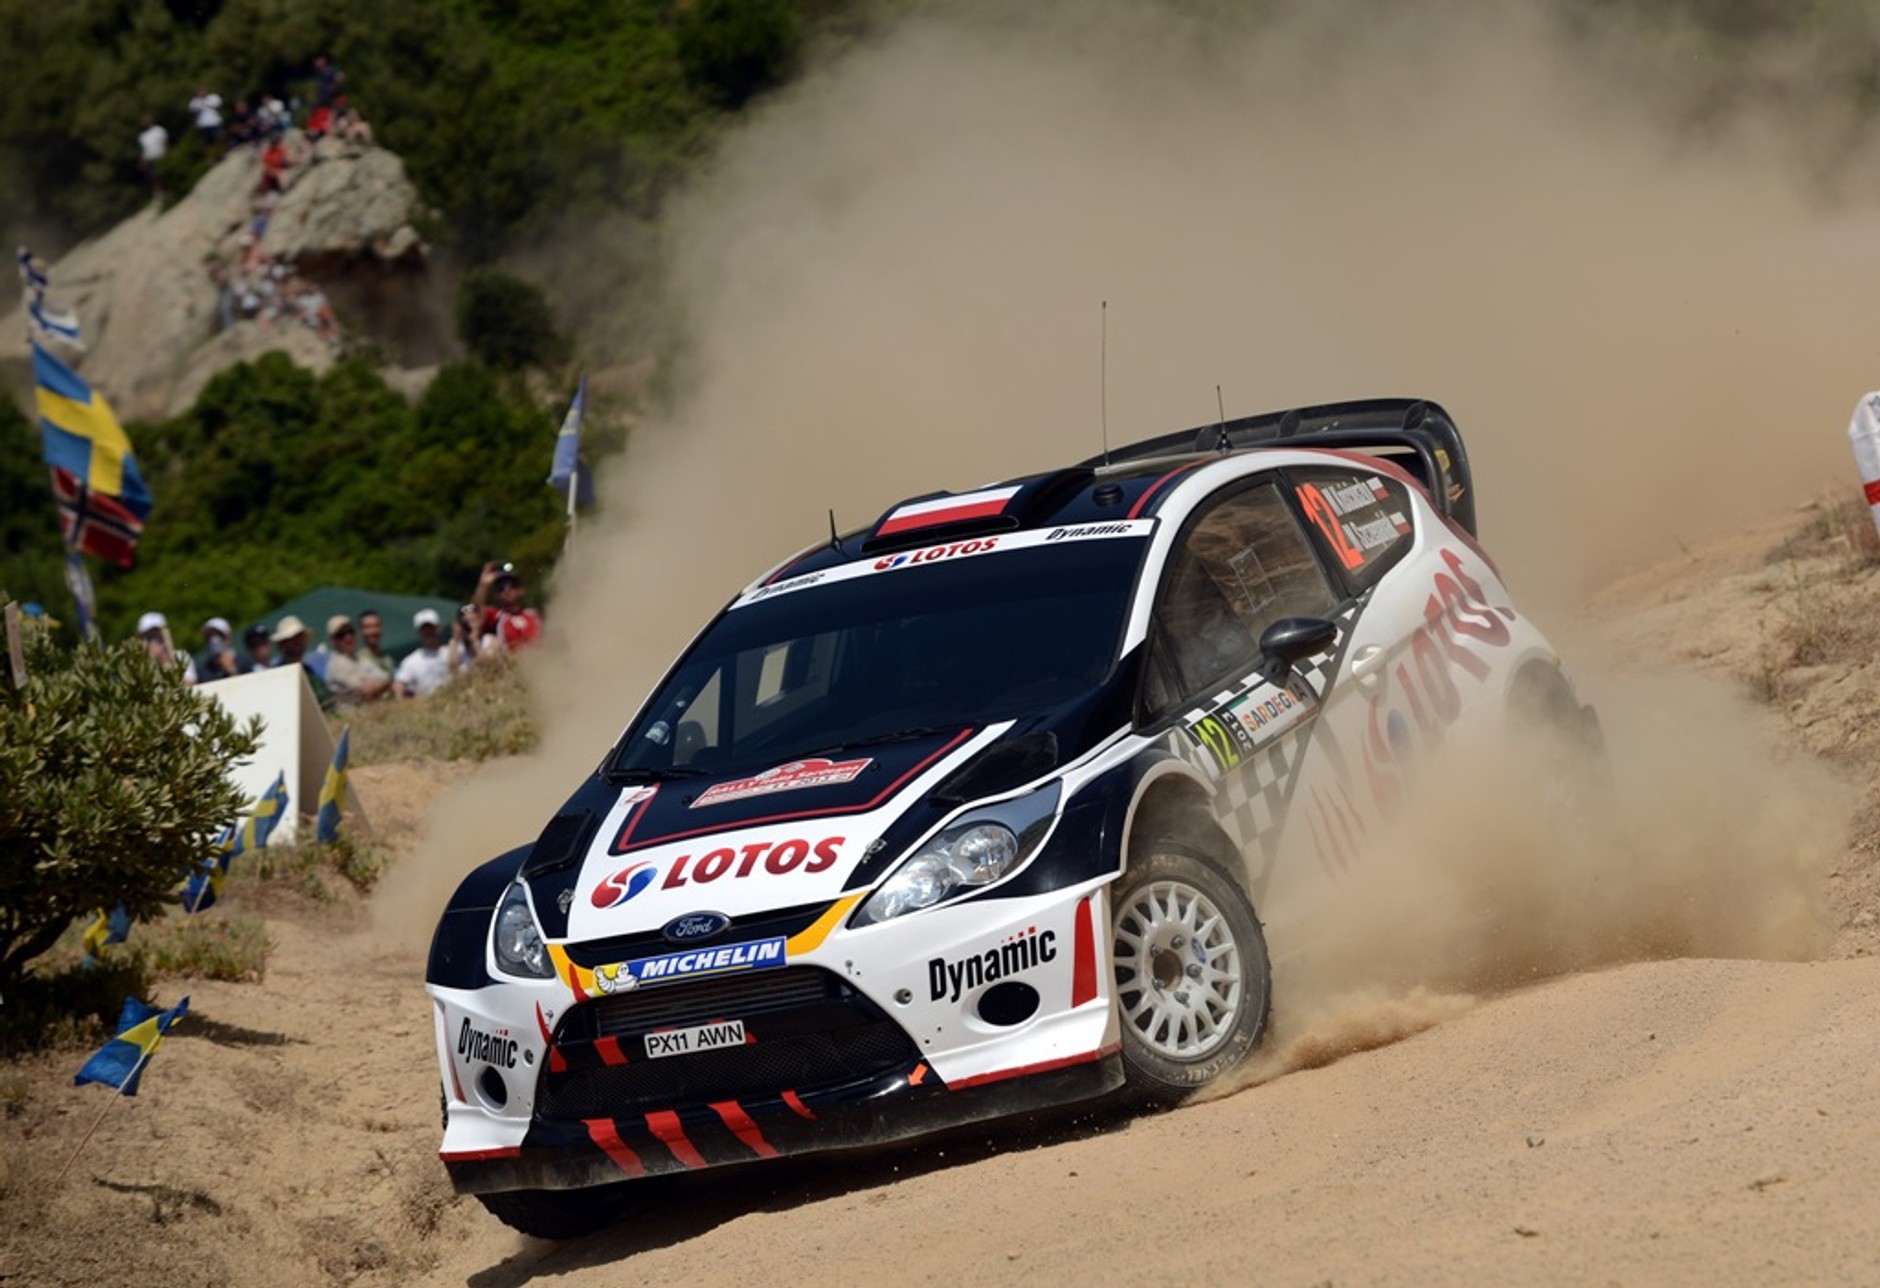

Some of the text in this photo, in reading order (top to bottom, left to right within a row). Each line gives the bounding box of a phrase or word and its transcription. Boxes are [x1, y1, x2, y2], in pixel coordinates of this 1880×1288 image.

[1045, 522, 1132, 541] Dynamic
[1295, 483, 1365, 569] 12
[911, 538, 999, 563] LOTOS
[1195, 717, 1240, 772] 12
[661, 836, 846, 890] LOTOS
[675, 916, 713, 938] Ford
[641, 941, 781, 979] MICHELIN
[928, 926, 1057, 1003] Dynamic
[458, 1016, 518, 1069] Dynamic
[647, 1024, 743, 1055] PX11 AWN
